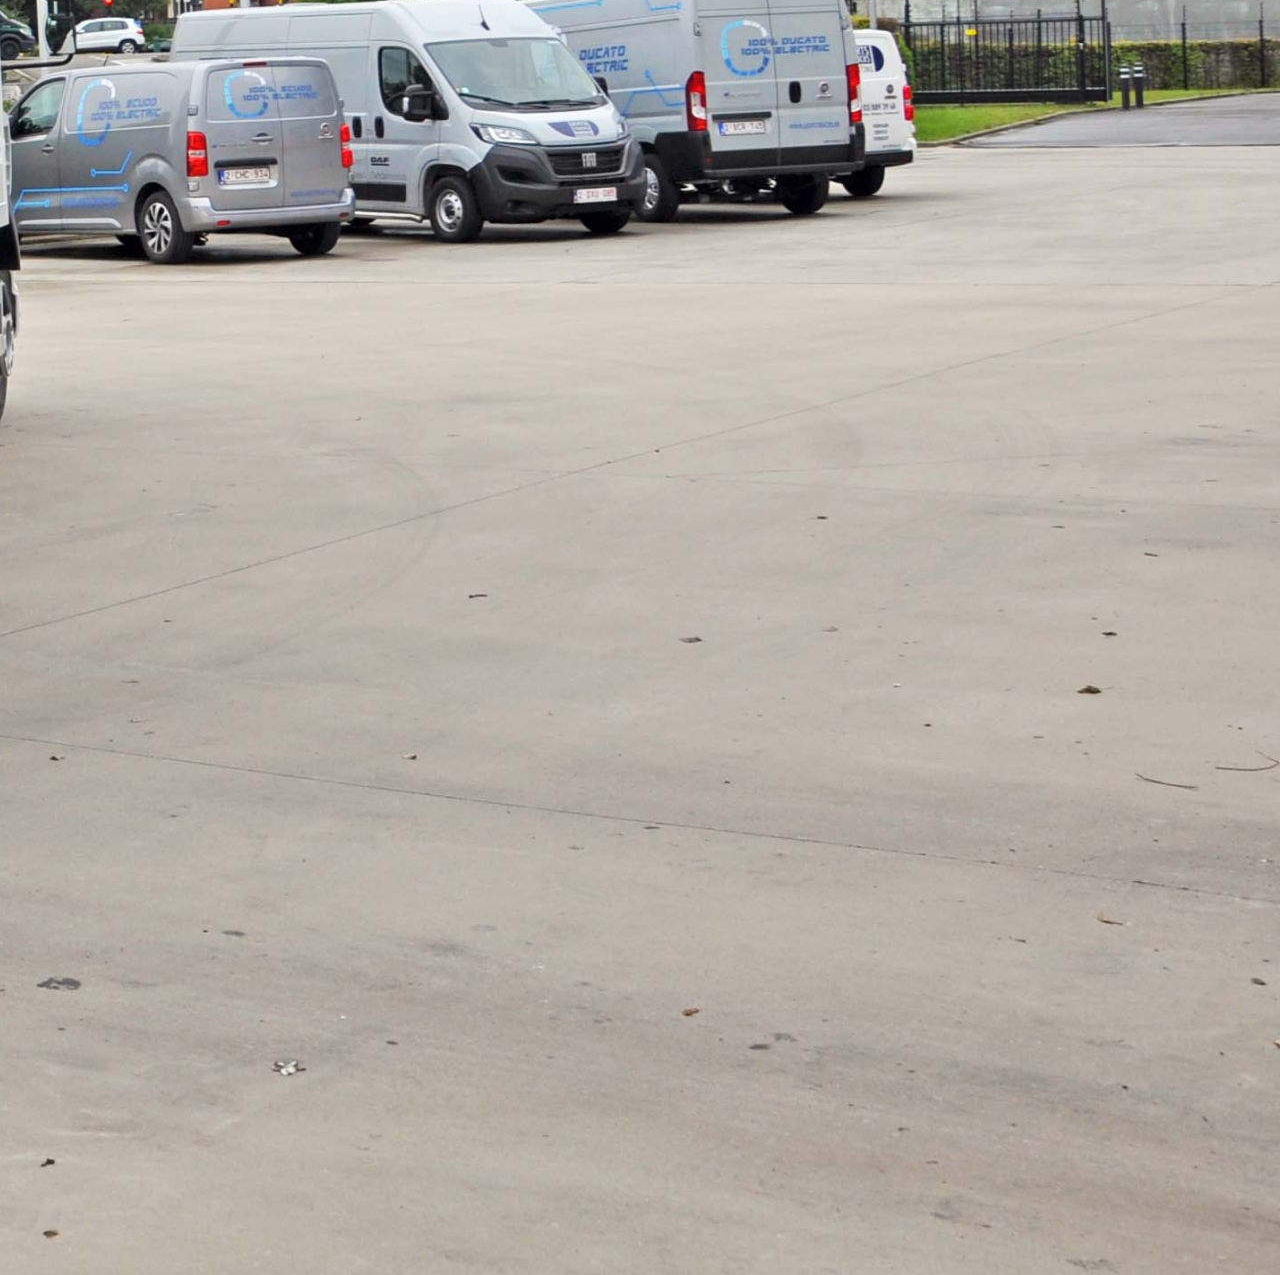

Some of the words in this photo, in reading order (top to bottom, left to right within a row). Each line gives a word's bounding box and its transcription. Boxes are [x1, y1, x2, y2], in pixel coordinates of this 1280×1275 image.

[781, 36, 826, 45] DUCATO
[579, 46, 626, 60] DUCATO
[774, 44, 830, 54] ELECTRIC
